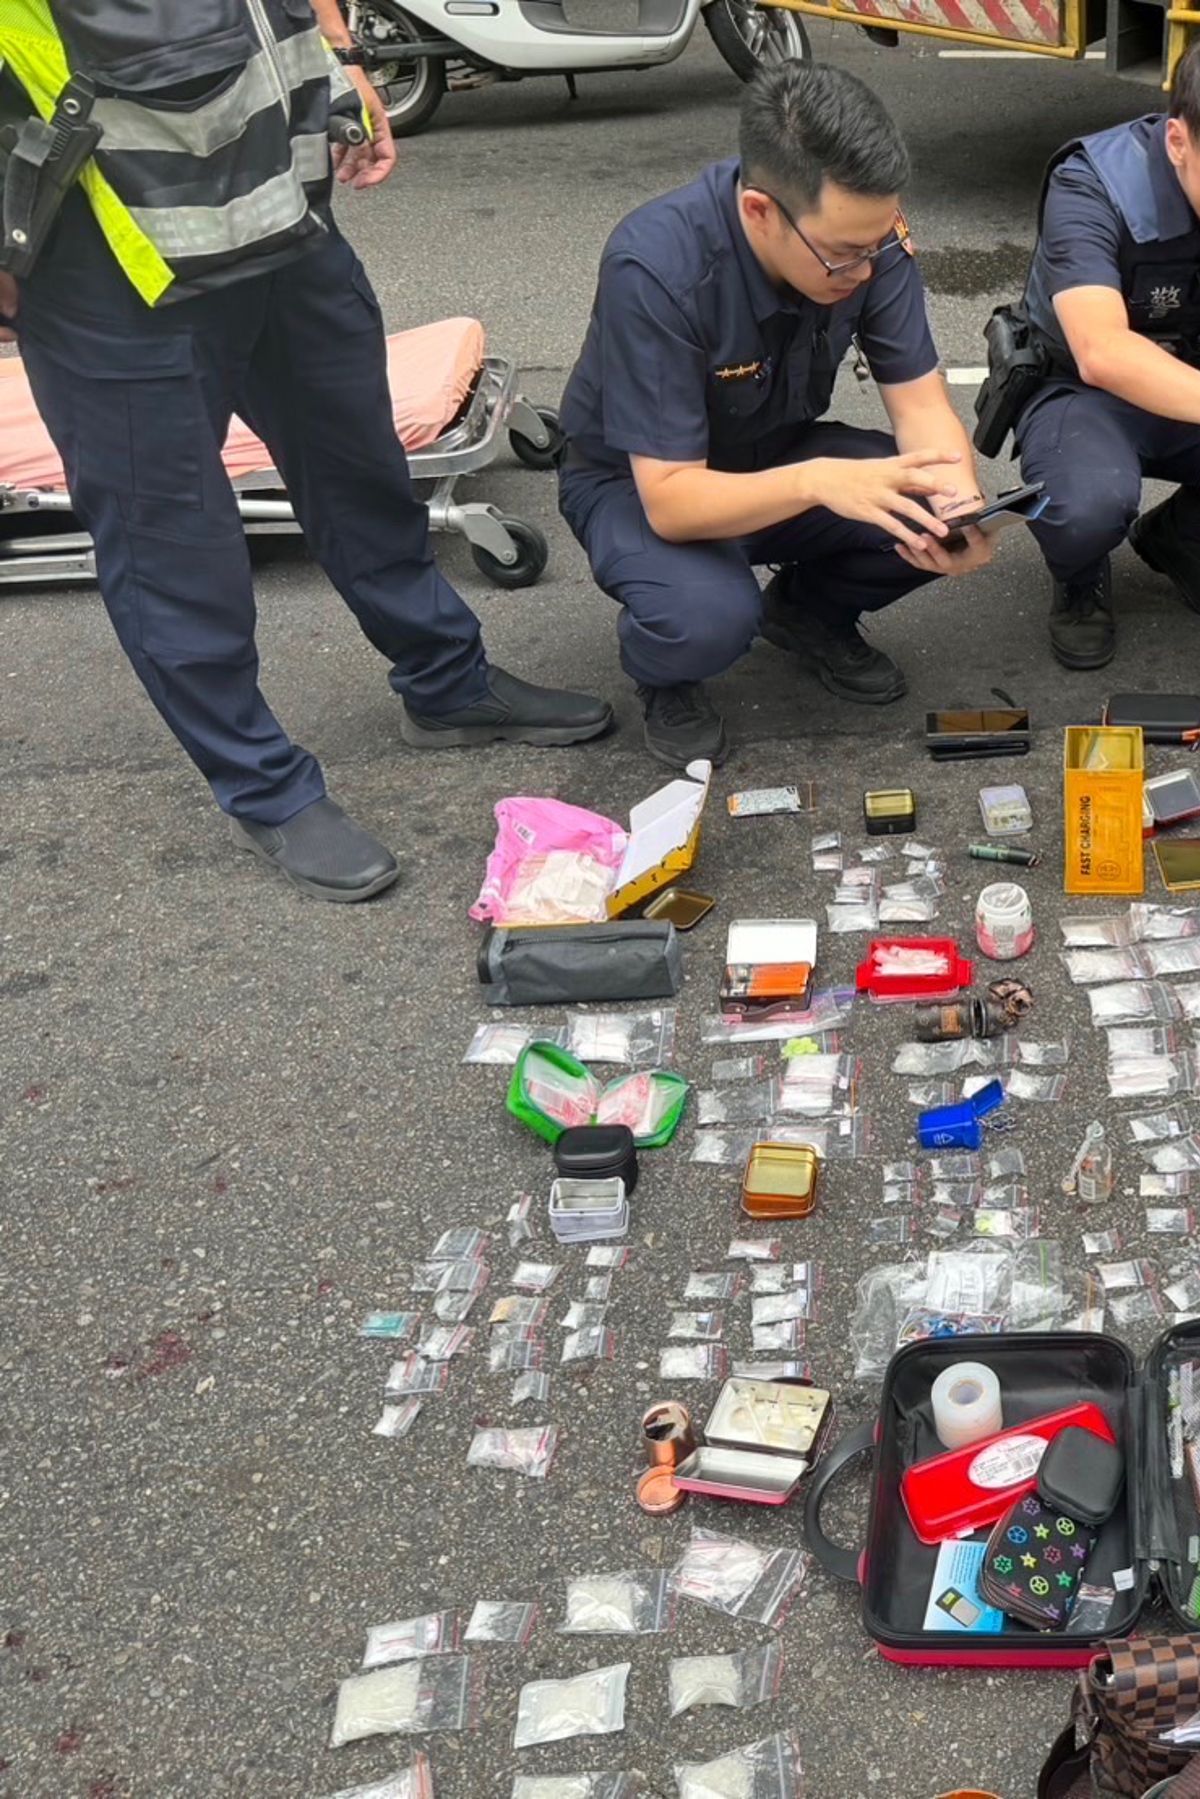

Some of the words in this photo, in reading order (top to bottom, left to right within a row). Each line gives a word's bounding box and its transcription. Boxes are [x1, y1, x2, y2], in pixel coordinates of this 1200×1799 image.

[1148, 285, 1181, 318] 警
[1079, 795, 1092, 850] CHARGING
[1080, 852, 1092, 876] FAST
